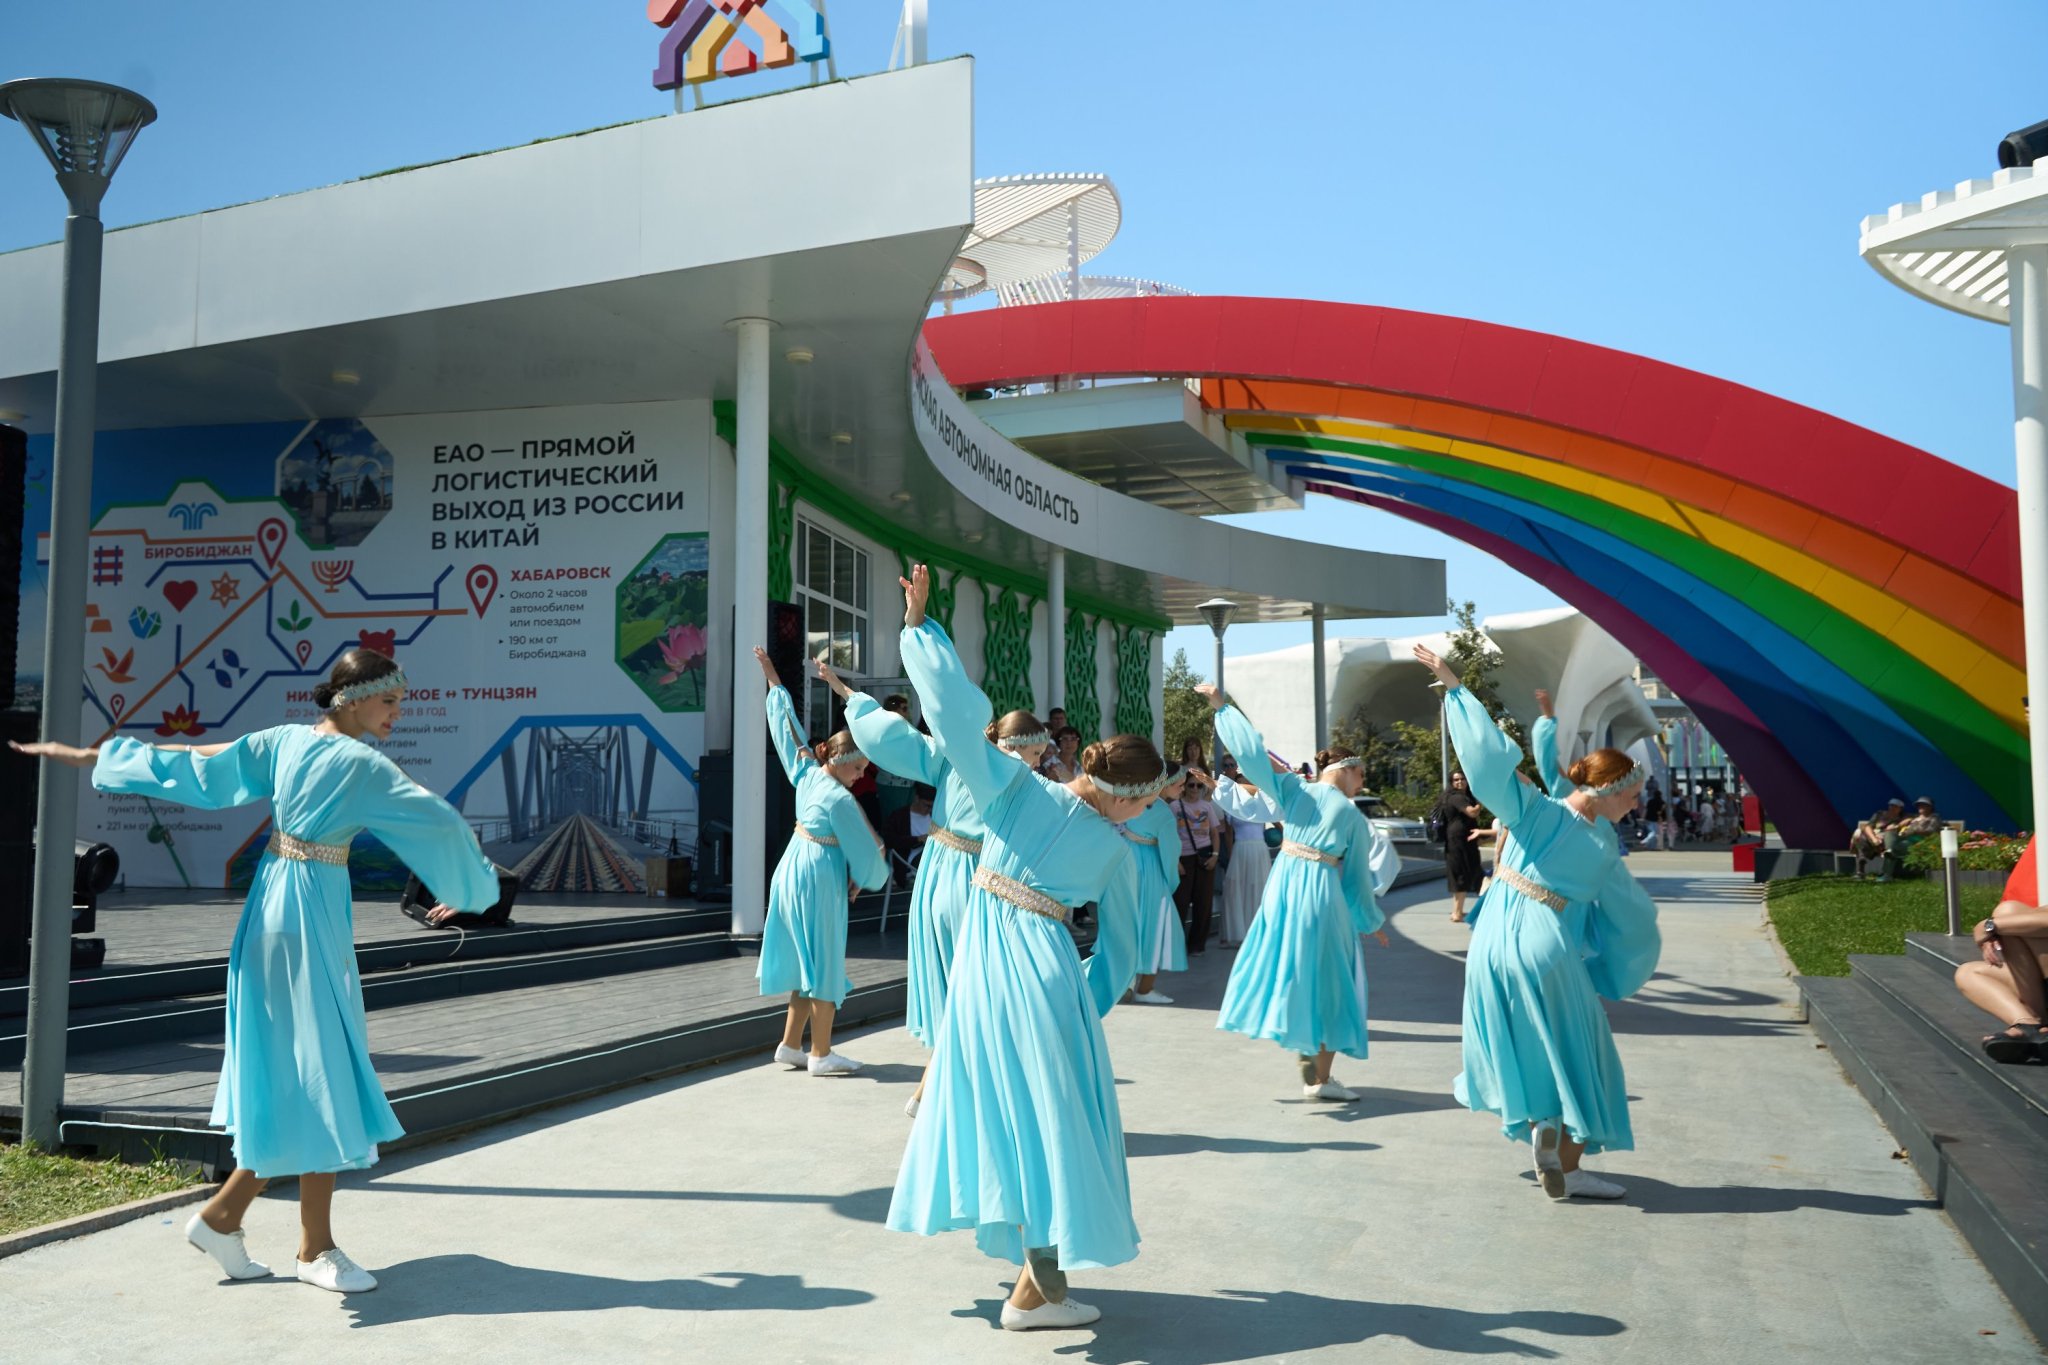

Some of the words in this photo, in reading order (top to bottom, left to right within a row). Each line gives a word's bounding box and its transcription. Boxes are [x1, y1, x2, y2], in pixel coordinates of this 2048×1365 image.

[433, 443, 485, 464] ЕАО
[522, 430, 636, 460] ПРЯМОЙ
[938, 408, 1012, 495] АВТОНОМНАЯ
[1014, 475, 1079, 525] ОБЛАСТЬ
[431, 459, 658, 493] ЛОГИСТИЧЕСКИЙ
[432, 499, 526, 522] ВЫХОД
[533, 497, 567, 517] ИЗ
[574, 491, 684, 515] РОССИИ
[431, 531, 447, 550] В
[454, 522, 540, 549] КИТАЙ
[144, 544, 253, 560] БИРОБИДЖАН
[510, 566, 611, 582] ХАБАРОВСК
[509, 590, 545, 600] Около
[547, 588, 554, 599] 2
[555, 588, 588, 599] часов
[509, 602, 585, 614] автомобилем
[509, 619, 531, 628] или
[533, 617, 582, 628] поездом
[508, 635, 527, 646] 190
[529, 636, 544, 645] км
[545, 635, 559, 645] от
[508, 648, 587, 660] Биробиджана
[462, 687, 537, 701] ТУНЦЗЯН
[426, 707, 447, 718] ГОД
[433, 725, 459, 734] мост
[107, 805, 136, 816] пункт
[150, 821, 222, 833] робиджана
